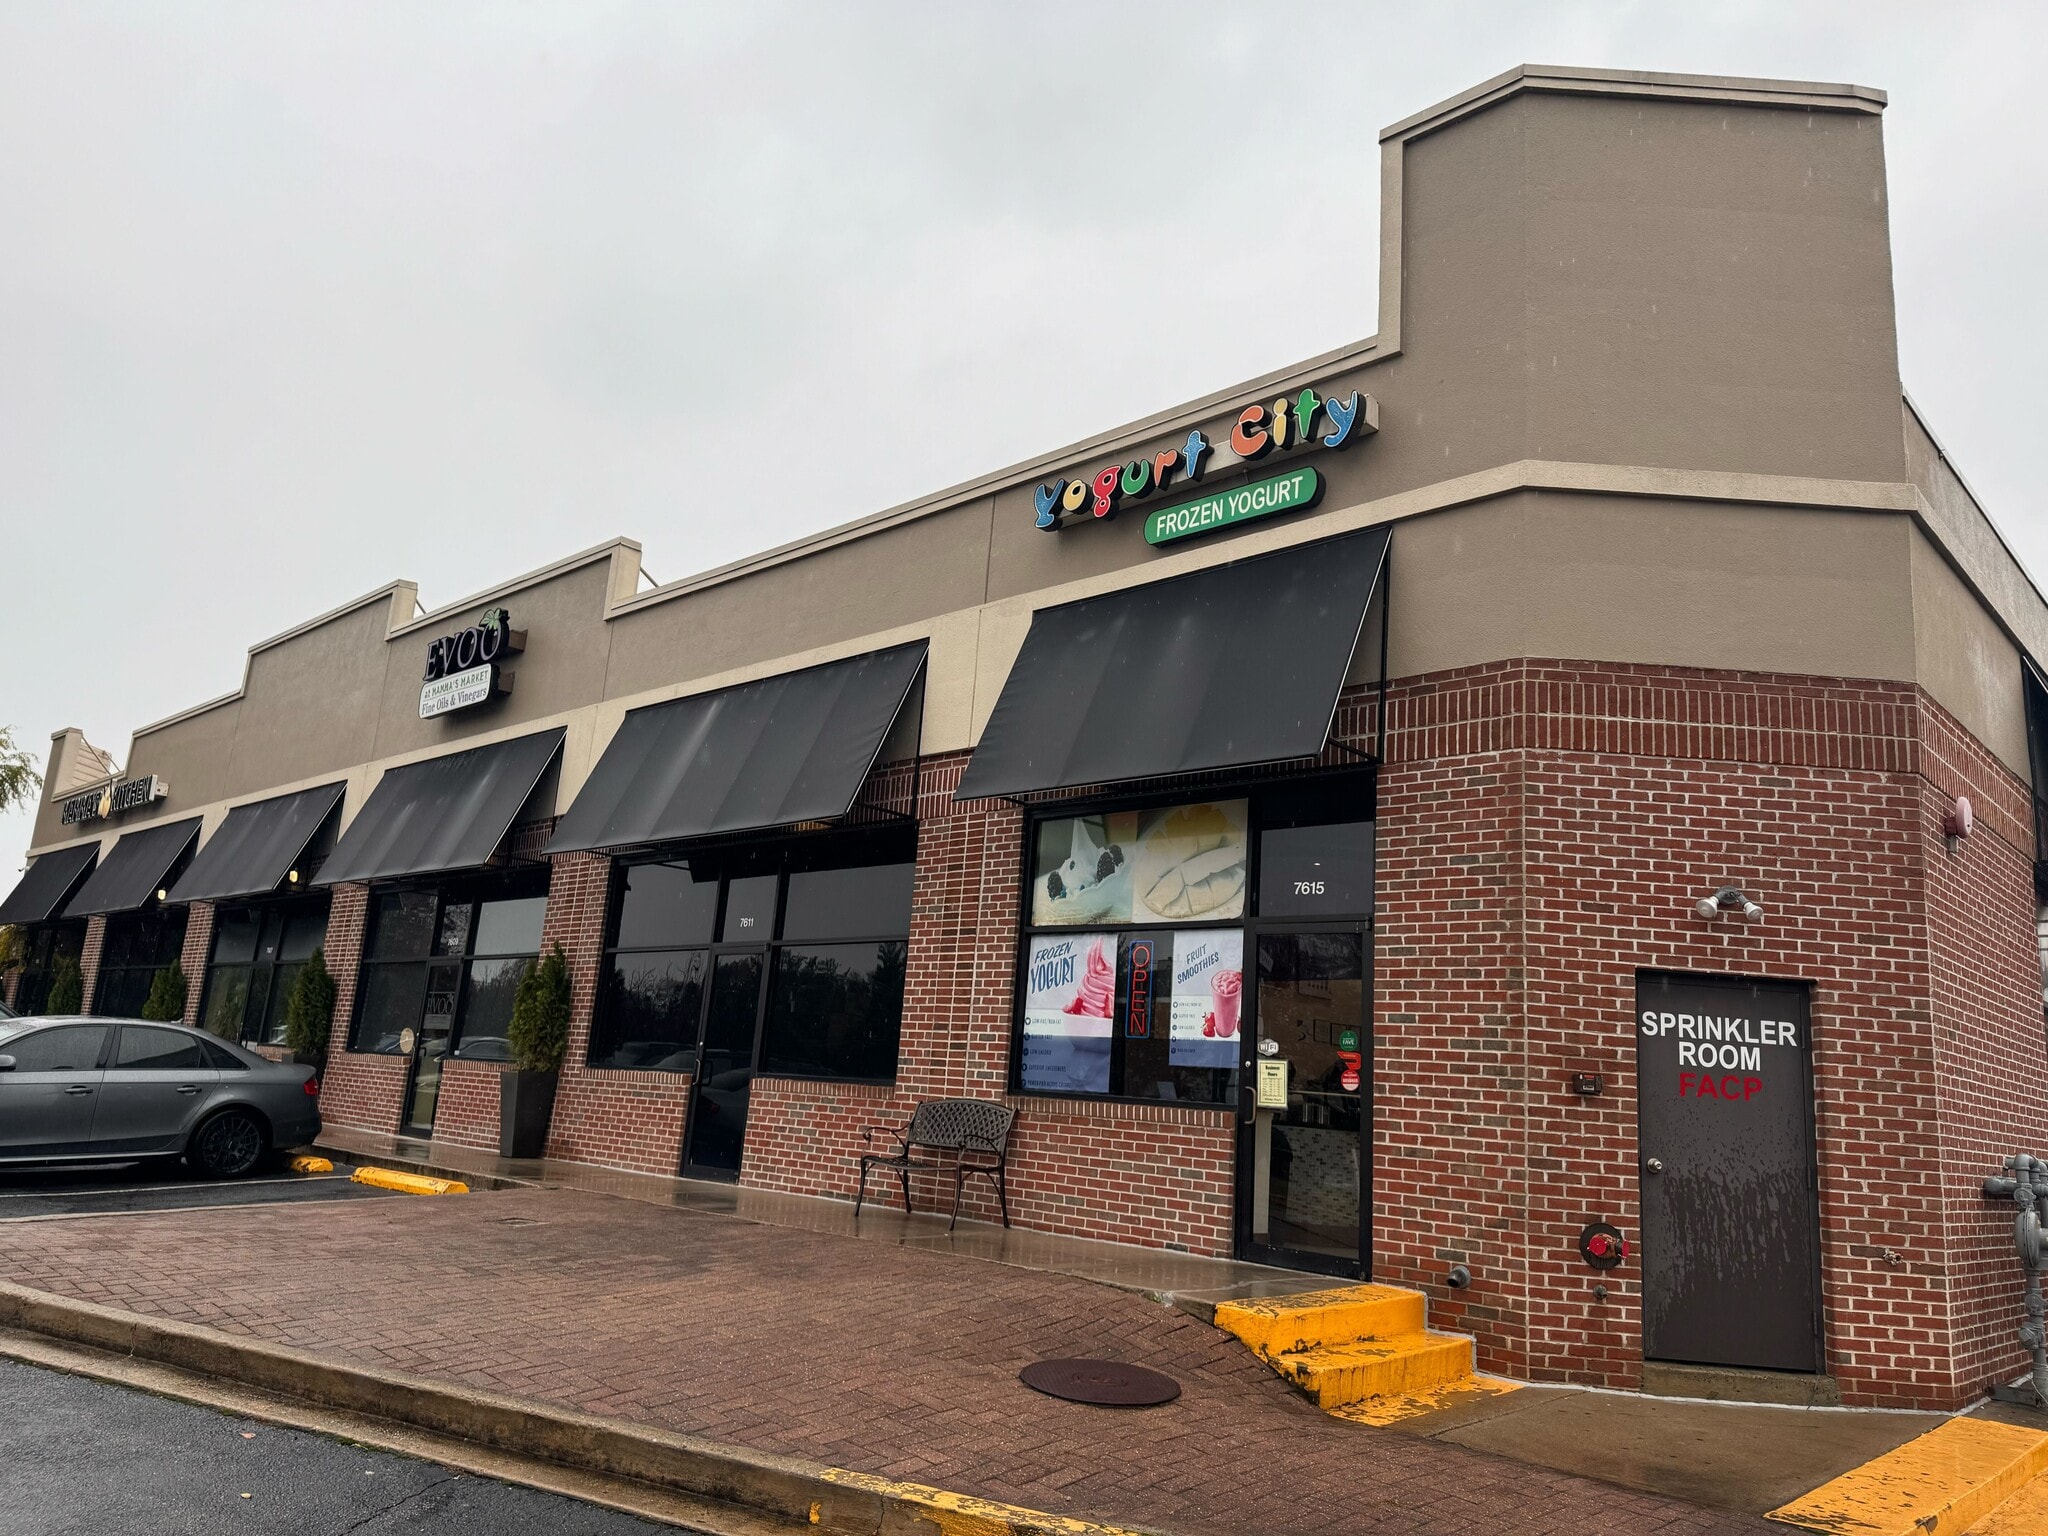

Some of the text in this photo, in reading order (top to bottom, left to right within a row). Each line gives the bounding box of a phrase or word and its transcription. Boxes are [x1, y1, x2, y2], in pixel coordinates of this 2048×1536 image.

[1156, 476, 1303, 538] FROZEN YOGURT
[423, 620, 502, 681] EVOO
[460, 670, 489, 687] MARKET
[421, 687, 488, 716] Fine Oils & Vinegars
[110, 774, 152, 812] KITCHEN
[1294, 881, 1325, 895] 7615
[740, 917, 754, 928] 7611
[1034, 941, 1073, 964] FROZEN
[1186, 944, 1207, 965] FRUIT
[1030, 954, 1078, 994] YOGURT
[1177, 951, 1220, 985] SMOOTHIES
[1131, 945, 1150, 1034] OPEN
[1641, 1010, 1798, 1047] SPRINKLER
[1678, 1041, 1761, 1071] ROOM
[1679, 1072, 1763, 1101] FACP
